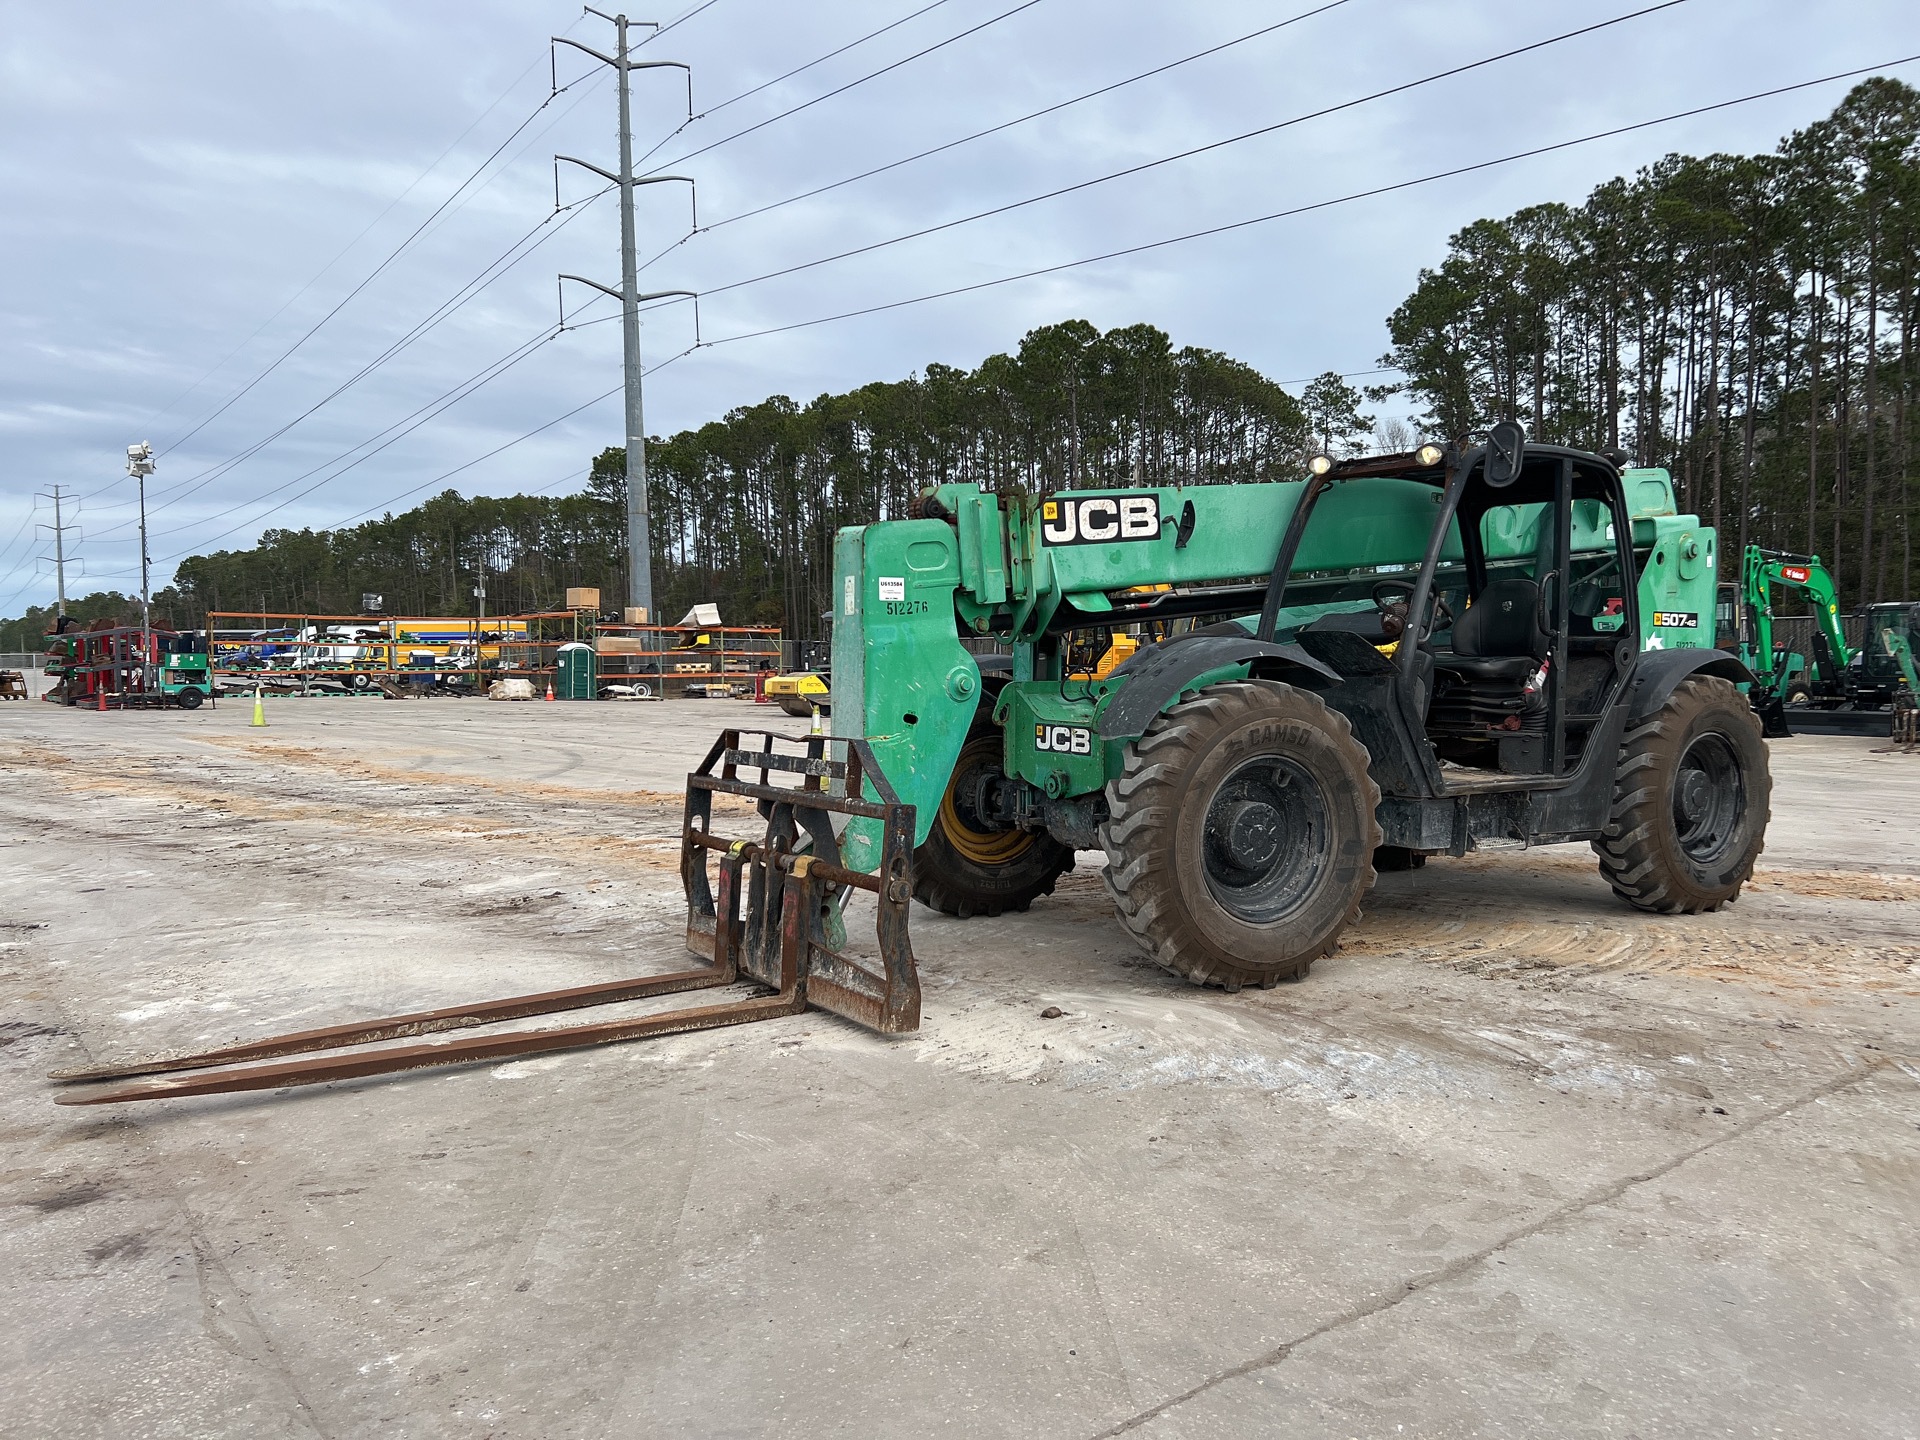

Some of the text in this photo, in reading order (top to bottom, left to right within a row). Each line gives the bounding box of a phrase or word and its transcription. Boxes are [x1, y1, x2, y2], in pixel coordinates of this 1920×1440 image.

[1044, 497, 1159, 543] JCB
[887, 600, 929, 616] 512276
[1661, 612, 1697, 627] 507-42
[1036, 725, 1091, 754] JCB
[1249, 723, 1312, 748] CAMSO
